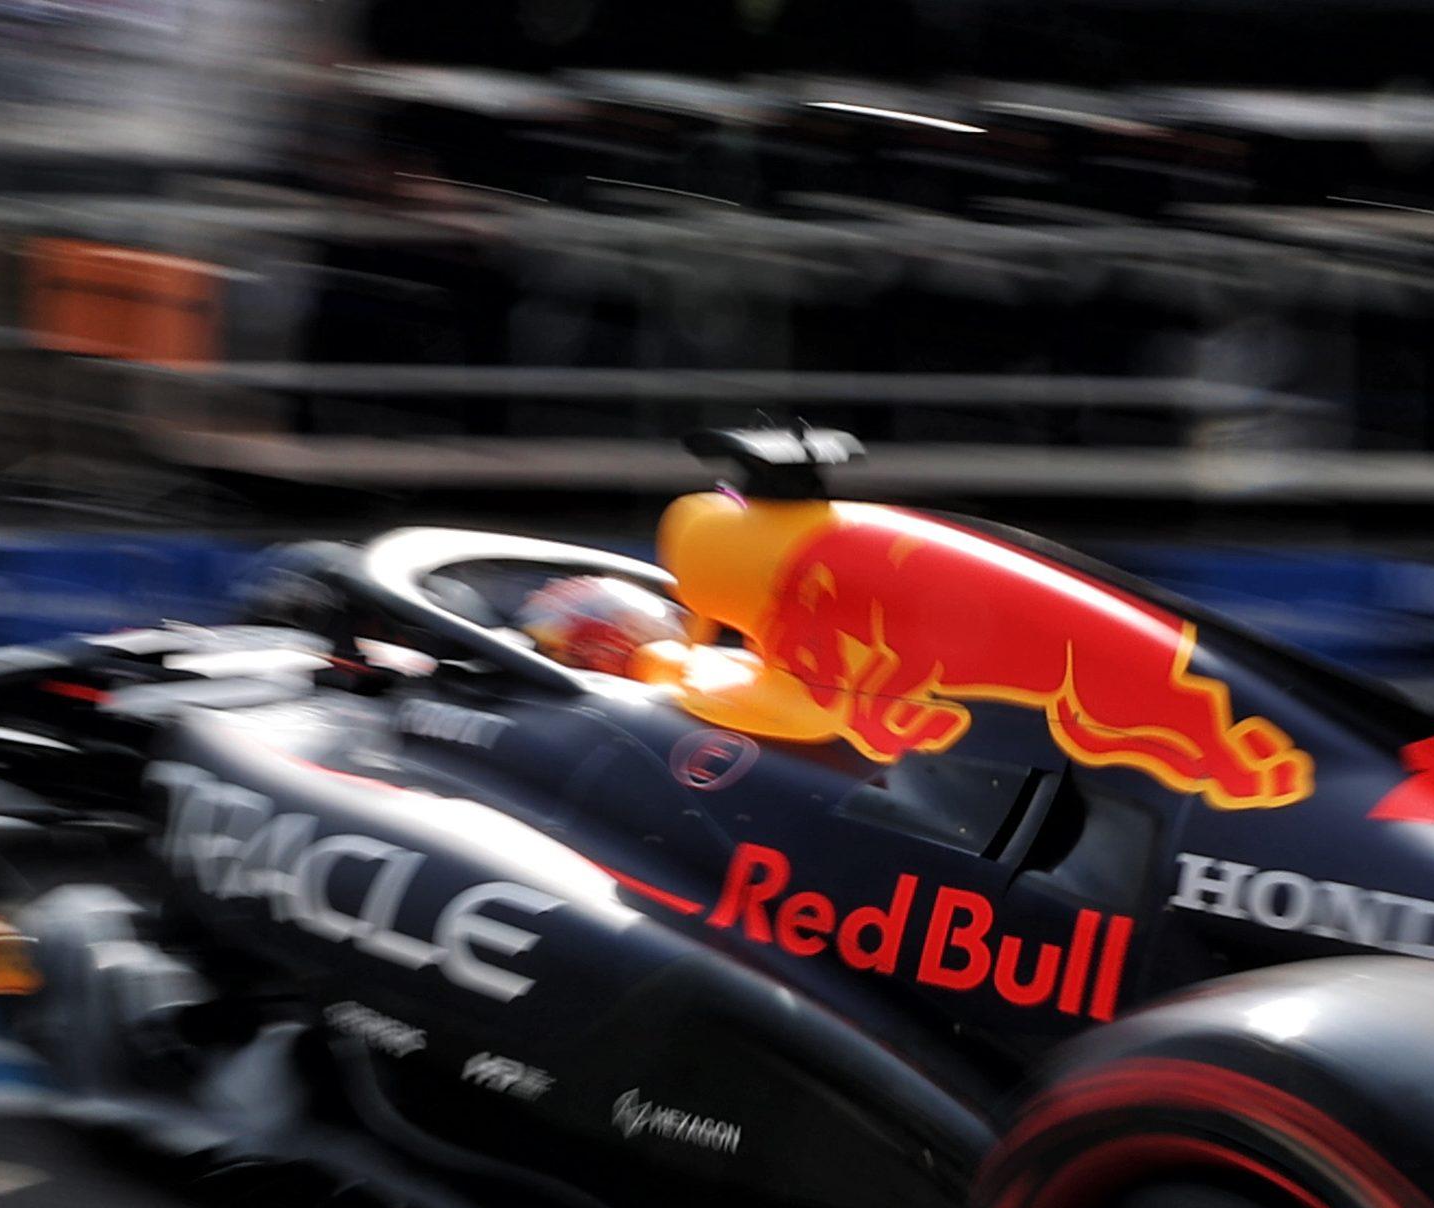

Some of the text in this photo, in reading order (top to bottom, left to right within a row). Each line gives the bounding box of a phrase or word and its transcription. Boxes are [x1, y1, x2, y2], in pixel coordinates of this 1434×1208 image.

[705, 842, 1134, 1023] Red Bull
[649, 1105, 742, 1154] HEXAGON
